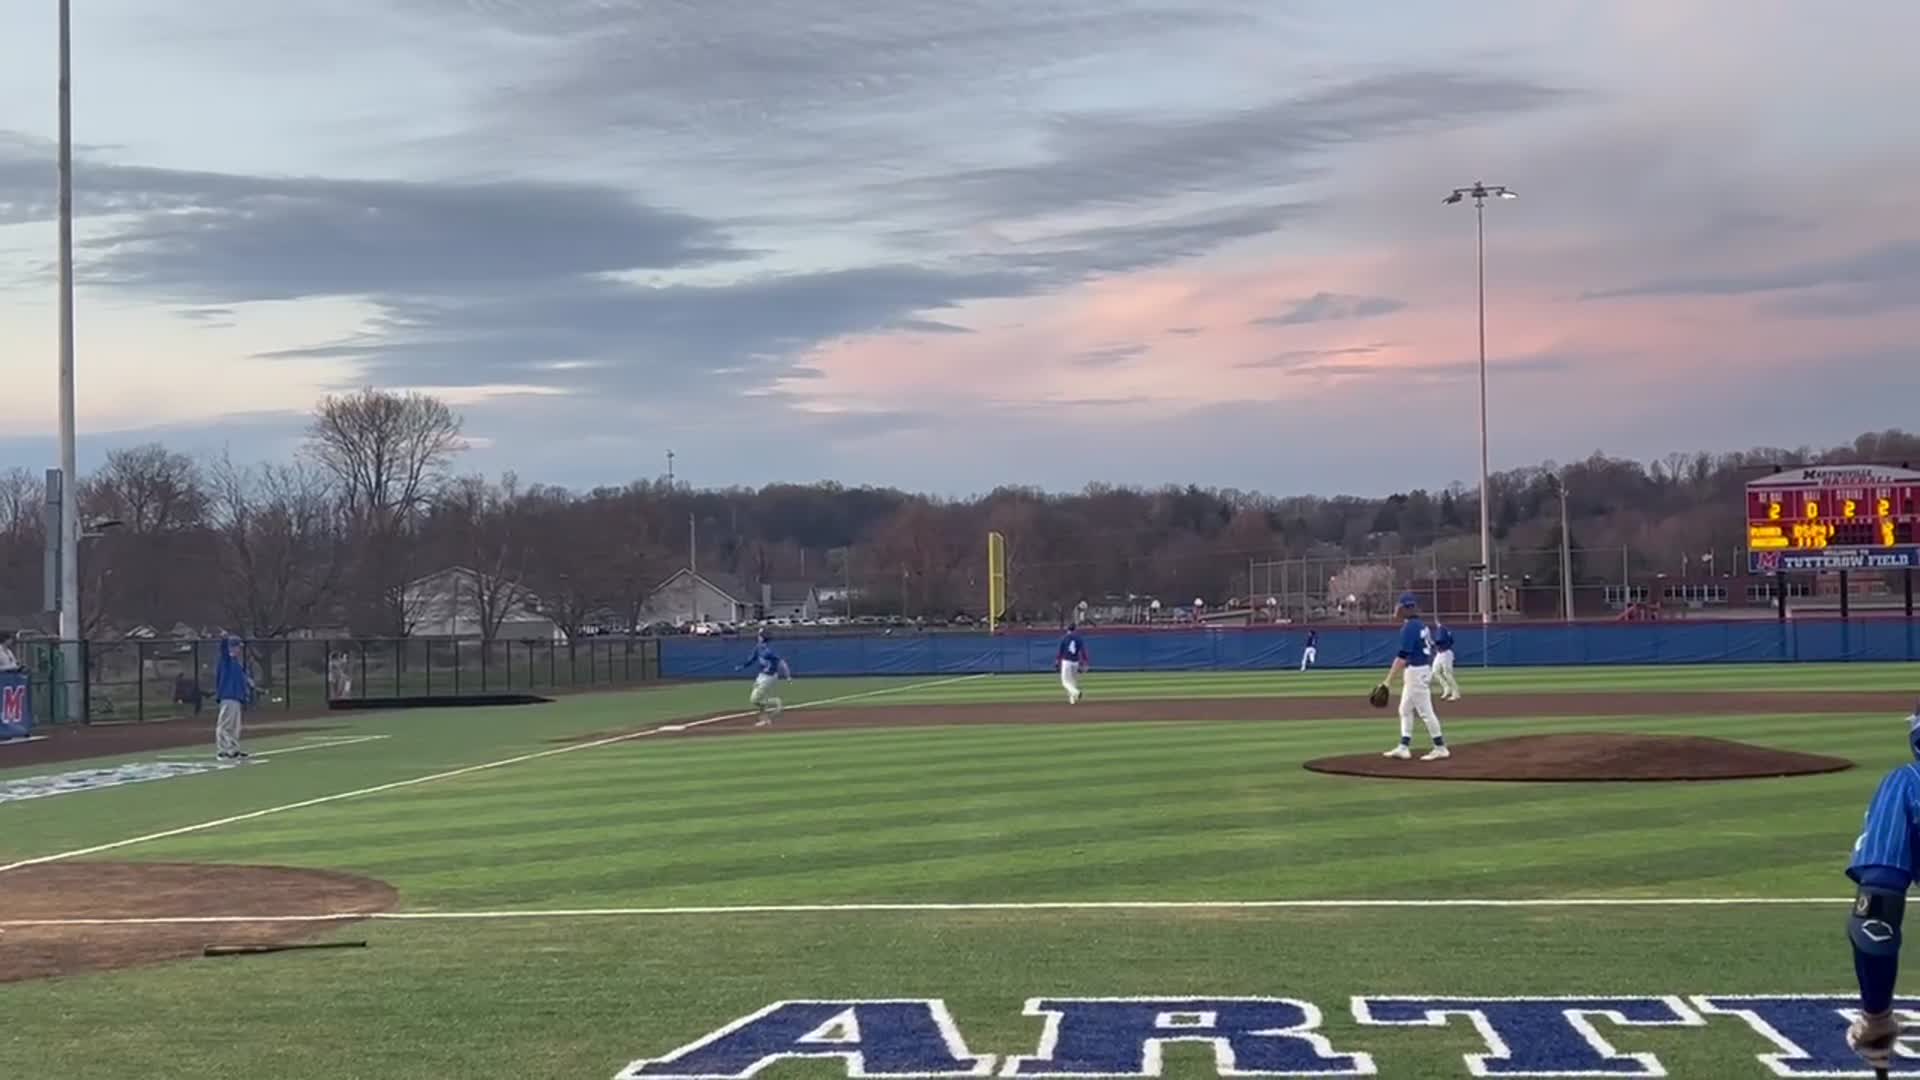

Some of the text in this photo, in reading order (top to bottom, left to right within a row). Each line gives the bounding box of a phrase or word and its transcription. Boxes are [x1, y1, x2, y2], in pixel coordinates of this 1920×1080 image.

[1769, 499, 1890, 519] 2 0 2 2
[1784, 553, 1910, 568] TUTTEROW FIELD
[1068, 639, 1077, 655] 4
[2, 684, 26, 724] M
